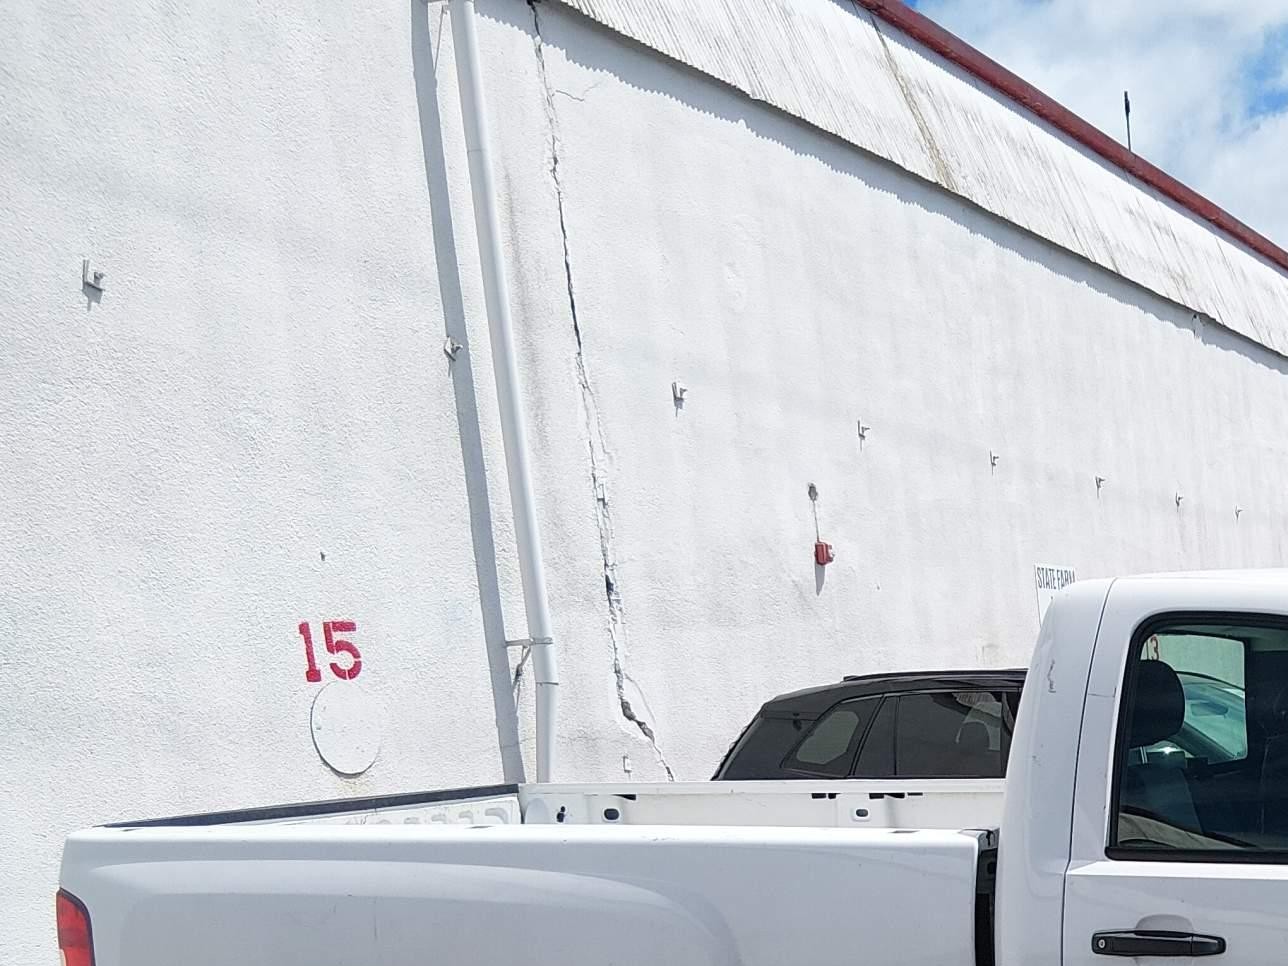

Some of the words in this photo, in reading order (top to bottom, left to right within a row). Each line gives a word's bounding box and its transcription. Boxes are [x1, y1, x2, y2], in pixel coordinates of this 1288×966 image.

[1036, 566, 1057, 590] STATE
[1056, 568, 1076, 591] FARM
[298, 620, 363, 682] 15
